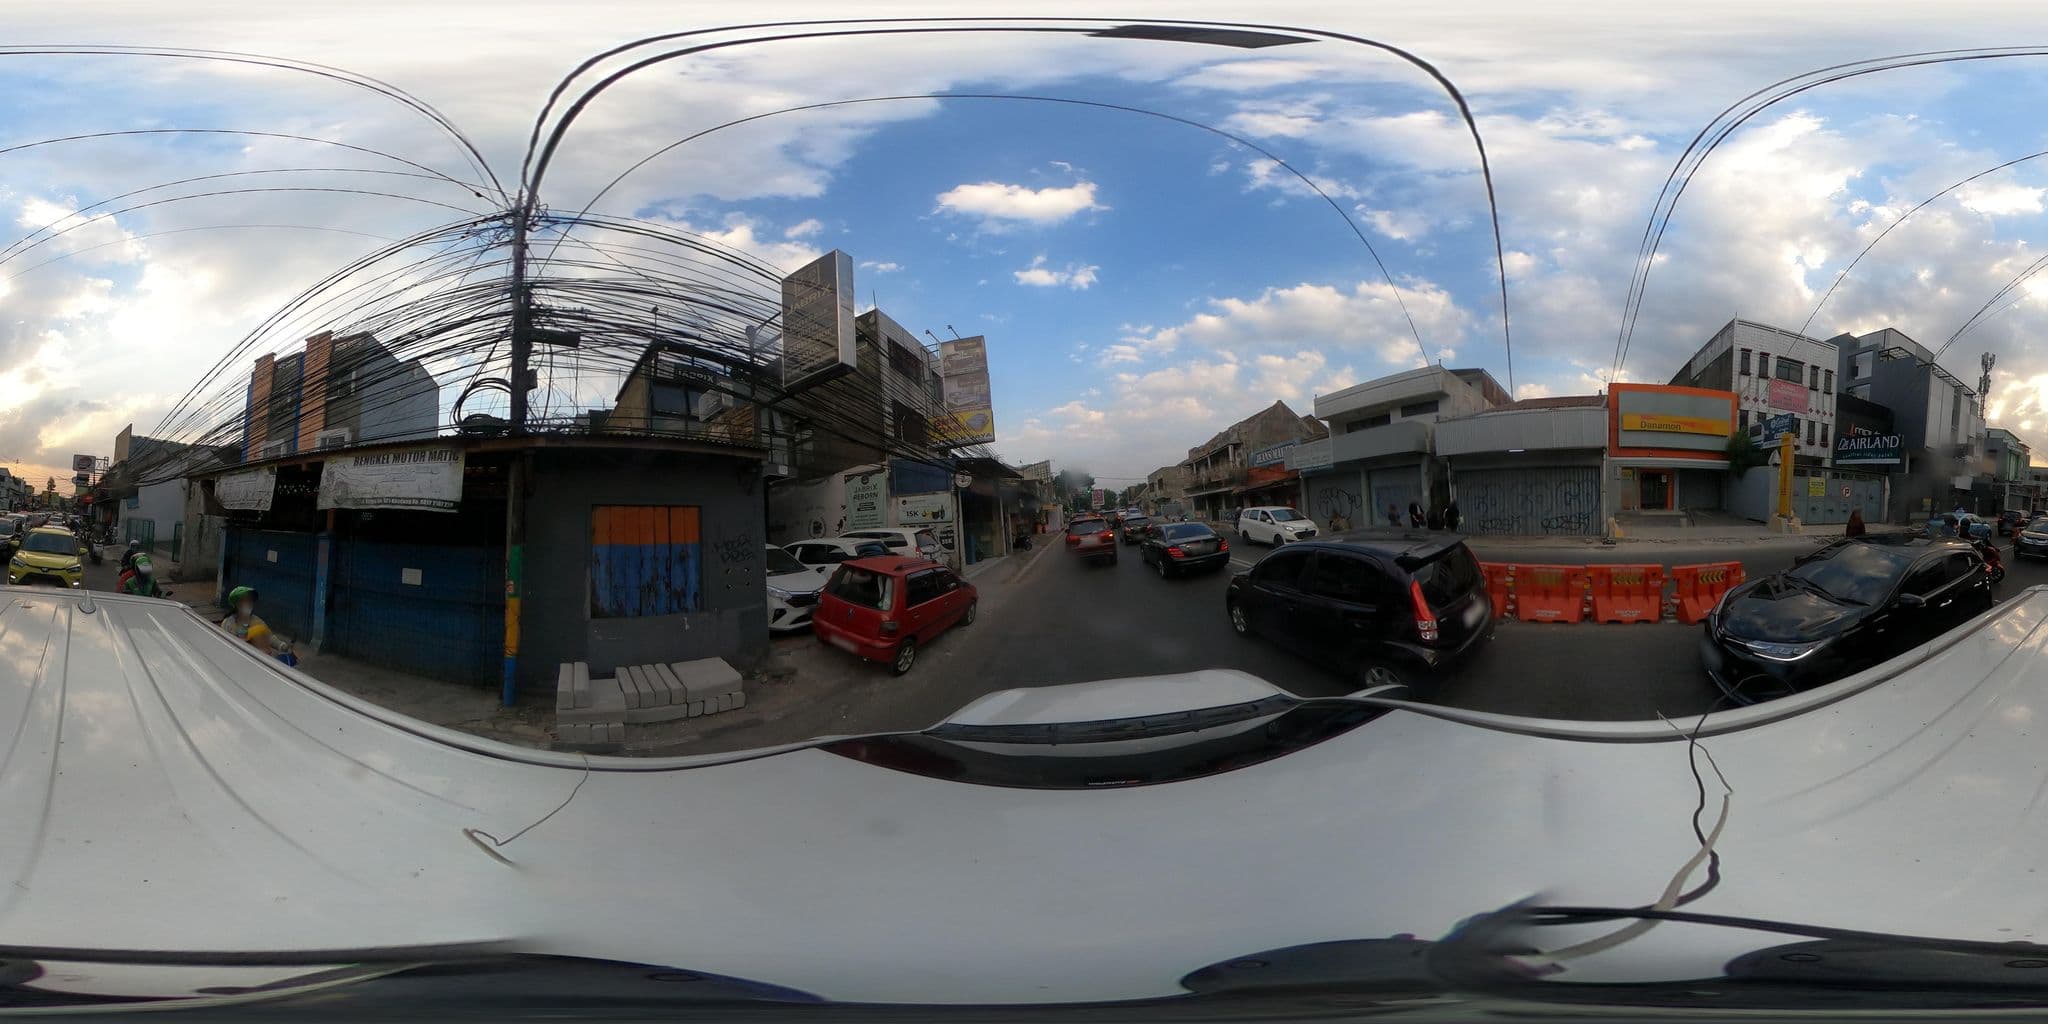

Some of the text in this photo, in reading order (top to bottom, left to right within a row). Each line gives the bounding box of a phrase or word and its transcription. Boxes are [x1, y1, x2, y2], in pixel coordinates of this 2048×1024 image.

[787, 283, 832, 316] JABRIX
[1640, 420, 1681, 430] Danamon
[1849, 435, 1900, 450] AIRLAND
[353, 449, 459, 466] BENGKEL MOTOR MATIC
[855, 483, 878, 493] JABRIX
[853, 492, 879, 500] REBORN
